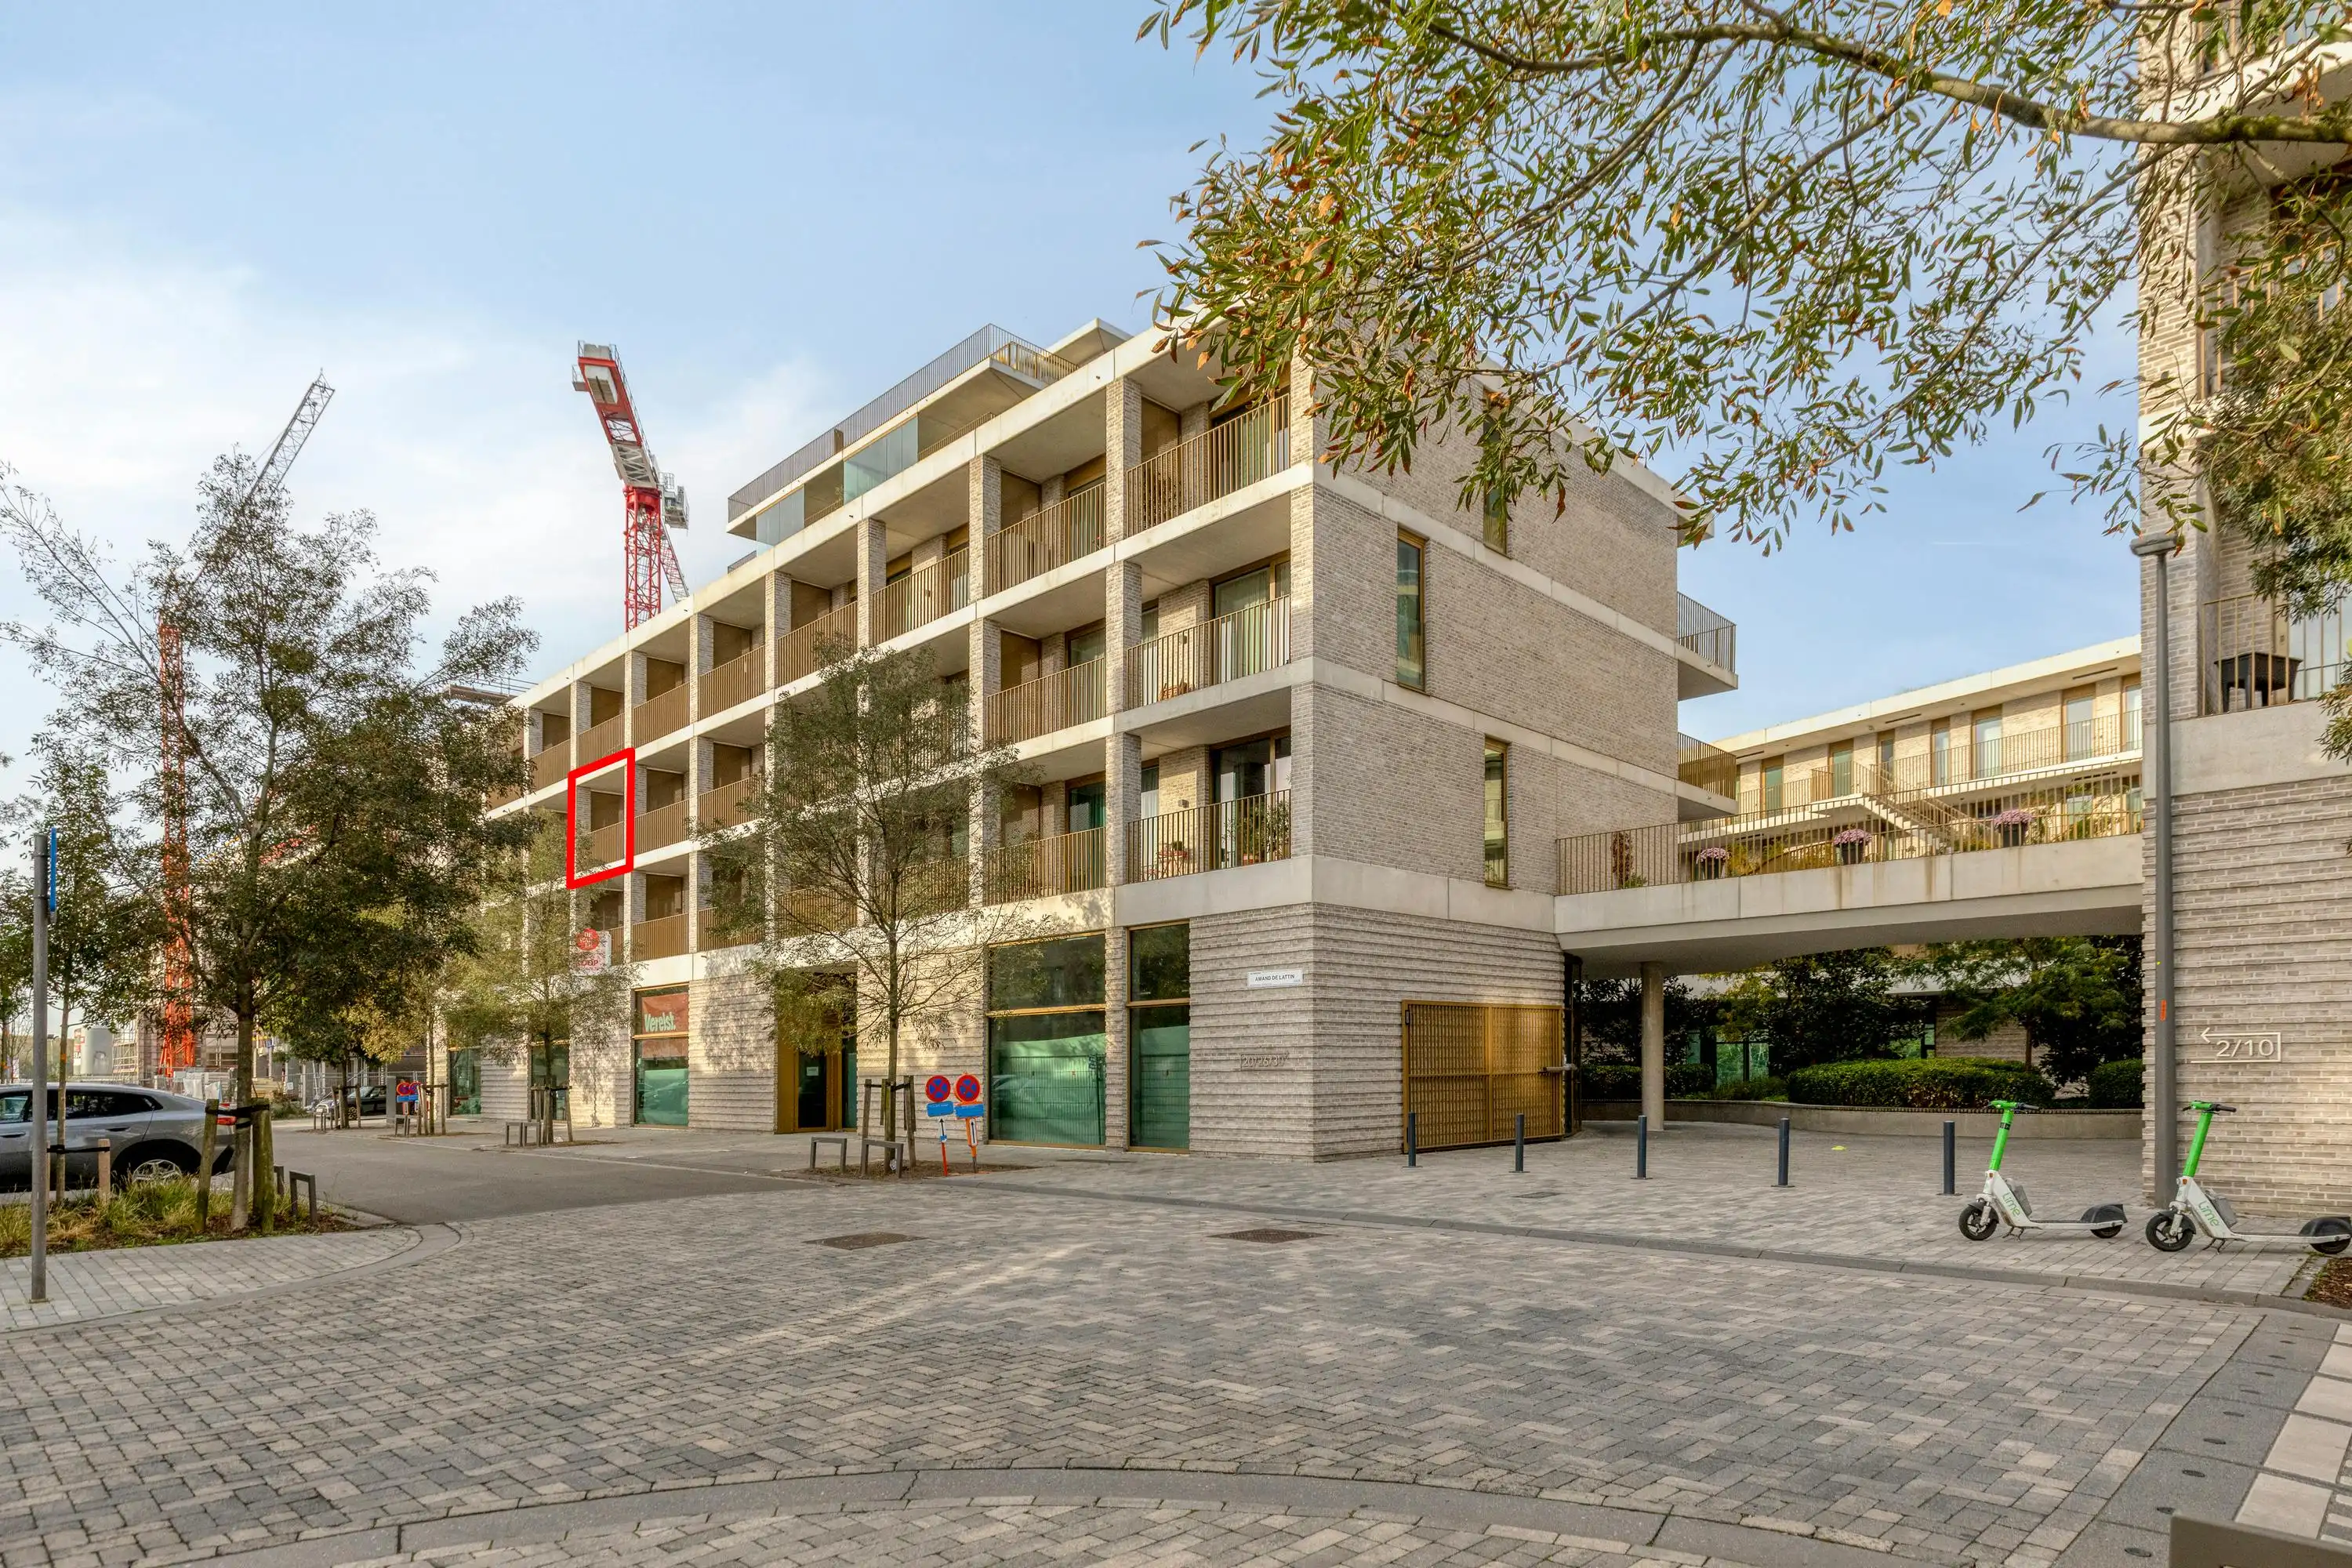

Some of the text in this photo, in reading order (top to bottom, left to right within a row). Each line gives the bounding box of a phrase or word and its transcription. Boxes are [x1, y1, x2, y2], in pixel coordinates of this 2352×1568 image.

[2216, 1039, 2274, 1057] 2/10
[2002, 1192, 2020, 1216] Lime
[2198, 1200, 2220, 1226] Lime
